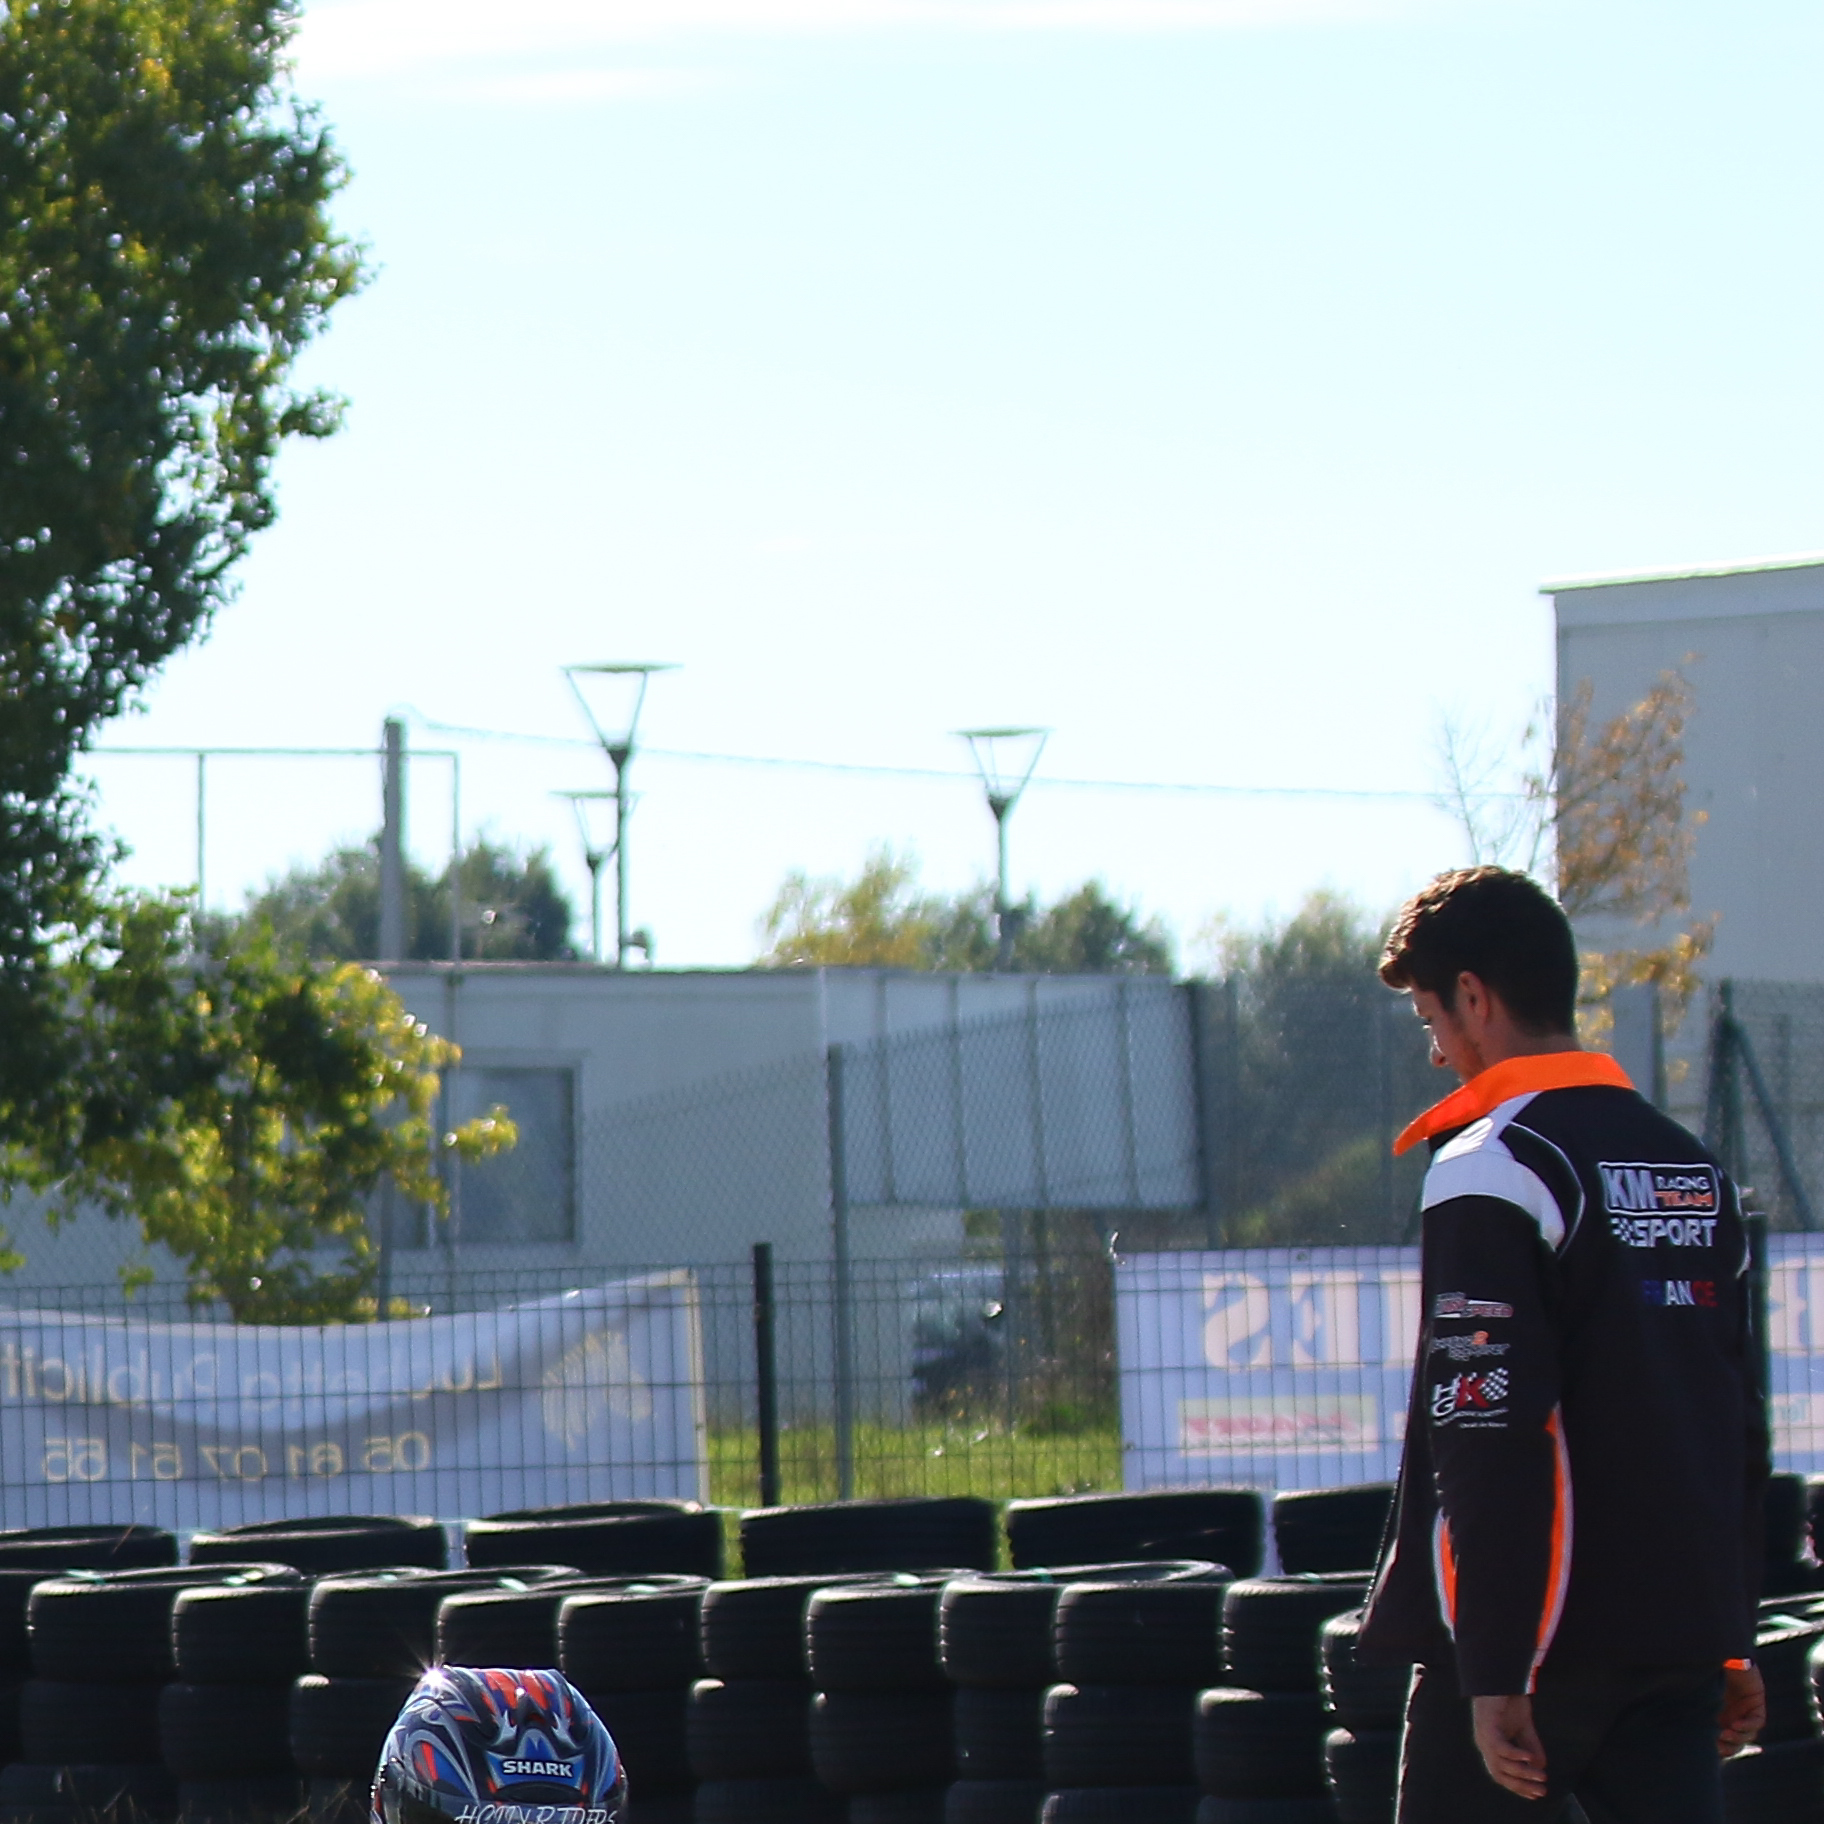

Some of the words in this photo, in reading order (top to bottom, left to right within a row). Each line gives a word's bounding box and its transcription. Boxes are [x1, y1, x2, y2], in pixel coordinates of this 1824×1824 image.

[1599, 1168, 1658, 1210] KM
[1655, 1175, 1710, 1190] RACING
[1653, 1190, 1714, 1207] TEAM
[1631, 1218, 1718, 1248] SPORT
[502, 1760, 573, 1778] SHARK
